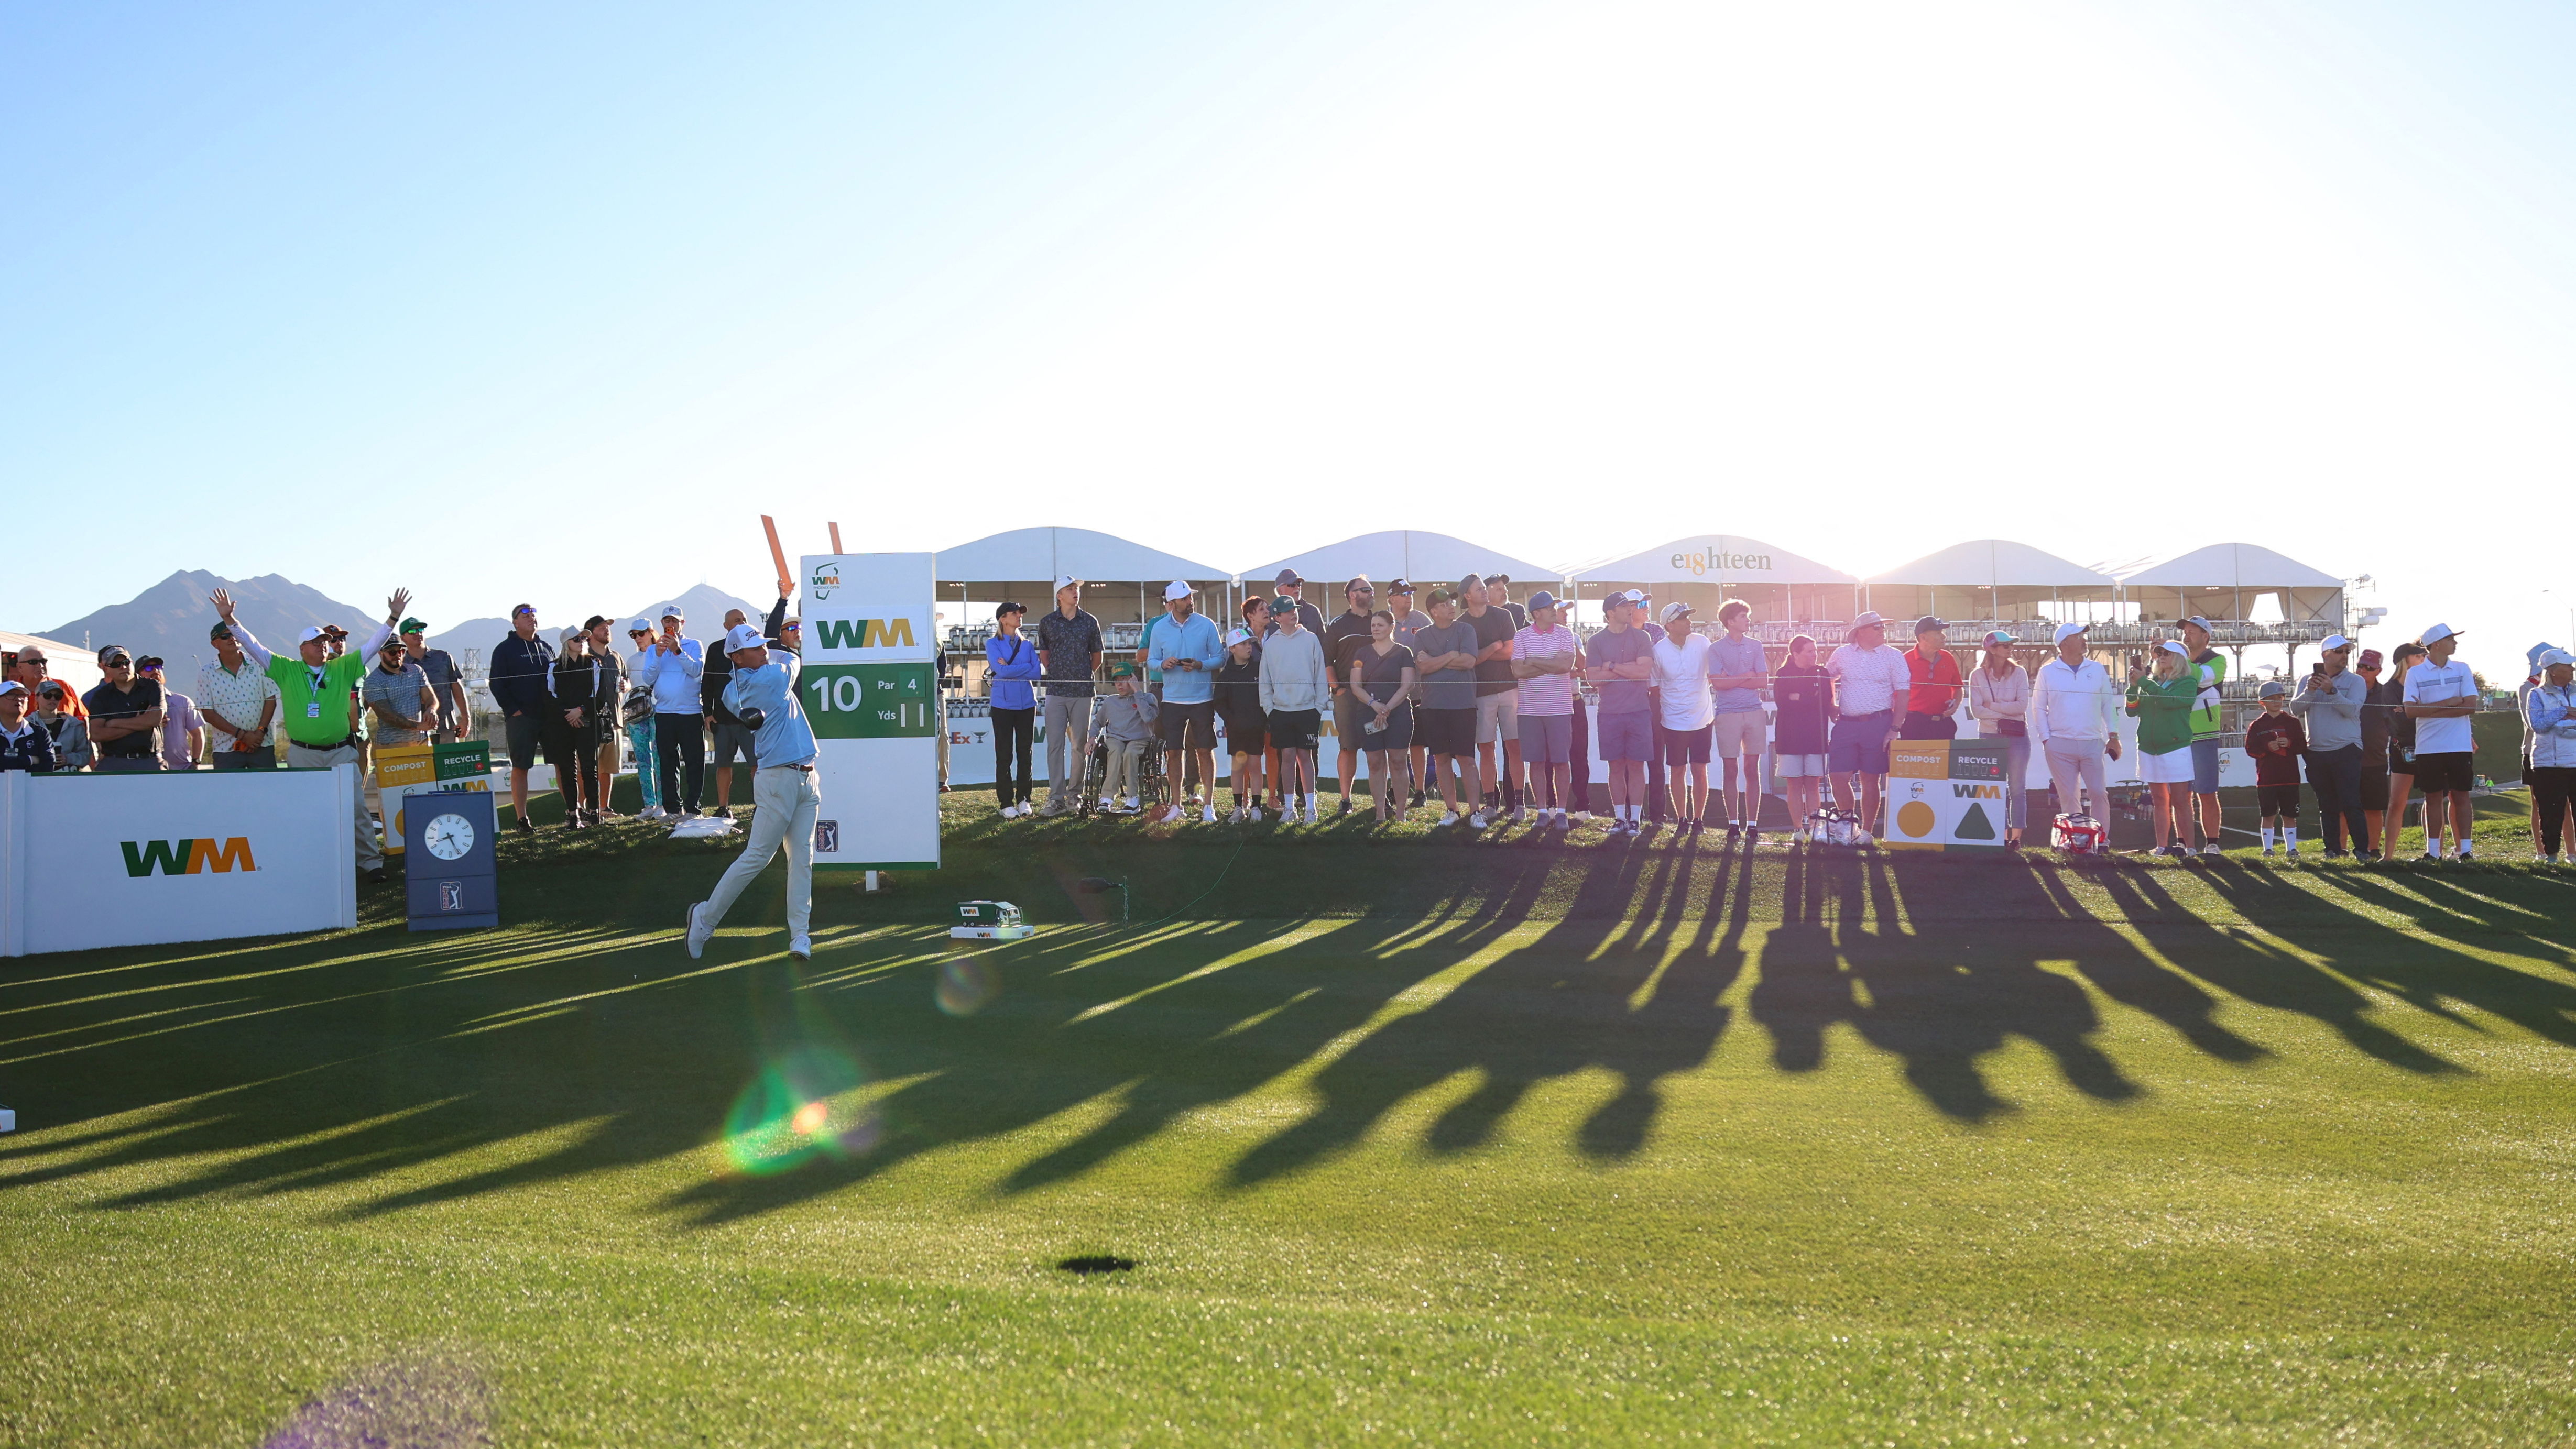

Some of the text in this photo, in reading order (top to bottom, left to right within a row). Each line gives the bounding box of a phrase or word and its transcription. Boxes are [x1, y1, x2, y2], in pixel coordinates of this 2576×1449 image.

[812, 576, 840, 585] WM
[816, 618, 915, 649] WM
[878, 678, 916, 690] Par 4
[811, 675, 862, 712] 10
[877, 710, 896, 720] Yds
[949, 732, 970, 744] dEx
[444, 754, 481, 765] RECYCLE
[1896, 755, 1941, 763] COMPOST
[1958, 756, 1998, 765] RECYCLE
[384, 761, 427, 773] COMPOST
[1953, 784, 2001, 799] WM
[120, 837, 256, 877] WM
